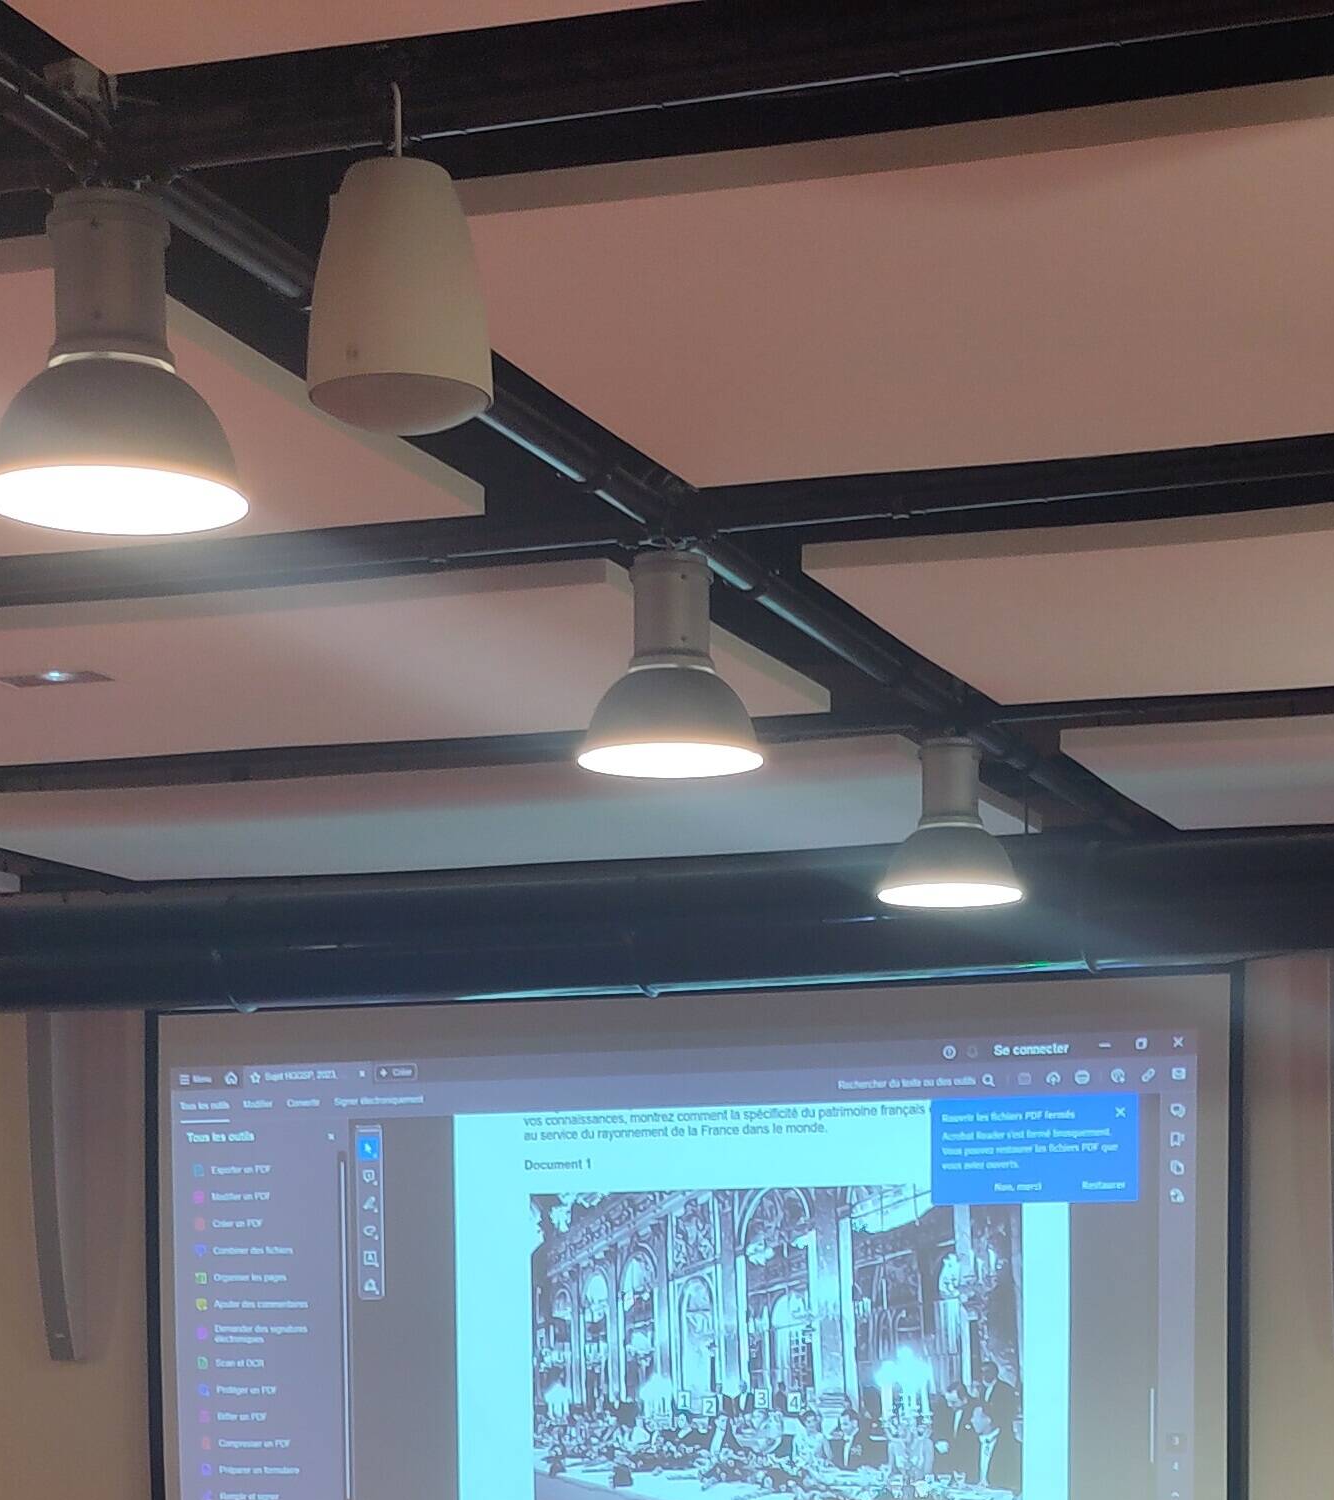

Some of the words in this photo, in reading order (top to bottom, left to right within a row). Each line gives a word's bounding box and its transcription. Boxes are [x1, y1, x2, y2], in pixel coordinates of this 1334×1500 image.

[994, 1045, 1009, 1056] Se
[1013, 1043, 1069, 1055] connecter
[524, 1116, 542, 1126] vos
[546, 1114, 627, 1125] connaissances,
[630, 1112, 674, 1123] montrez
[677, 1109, 728, 1122] comment
[730, 1110, 741, 1119] la
[743, 1107, 798, 1122] spécificité
[802, 1107, 815, 1118] du
[819, 1104, 877, 1119] patrimoine
[881, 1104, 925, 1116] français
[1025, 1111, 1042, 1120] PDF
[187, 1132, 210, 1143] Tous
[228, 1130, 255, 1142] outils
[524, 1131, 538, 1141] au
[540, 1130, 578, 1141] service
[581, 1129, 594, 1139] du
[597, 1126, 668, 1142] rayonnement
[671, 1126, 685, 1136] de
[688, 1125, 697, 1136] la
[701, 1123, 739, 1135] France
[743, 1124, 769, 1135] dans
[773, 1124, 782, 1134] le
[786, 1122, 827, 1134] monde.
[1082, 1143, 1099, 1152] PDF
[525, 1159, 582, 1170] Document
[586, 1158, 591, 1169] 1
[682, 1394, 687, 1408] 1
[758, 1392, 765, 1405] 3
[790, 1396, 798, 1410] 4
[706, 1401, 713, 1414] 2
